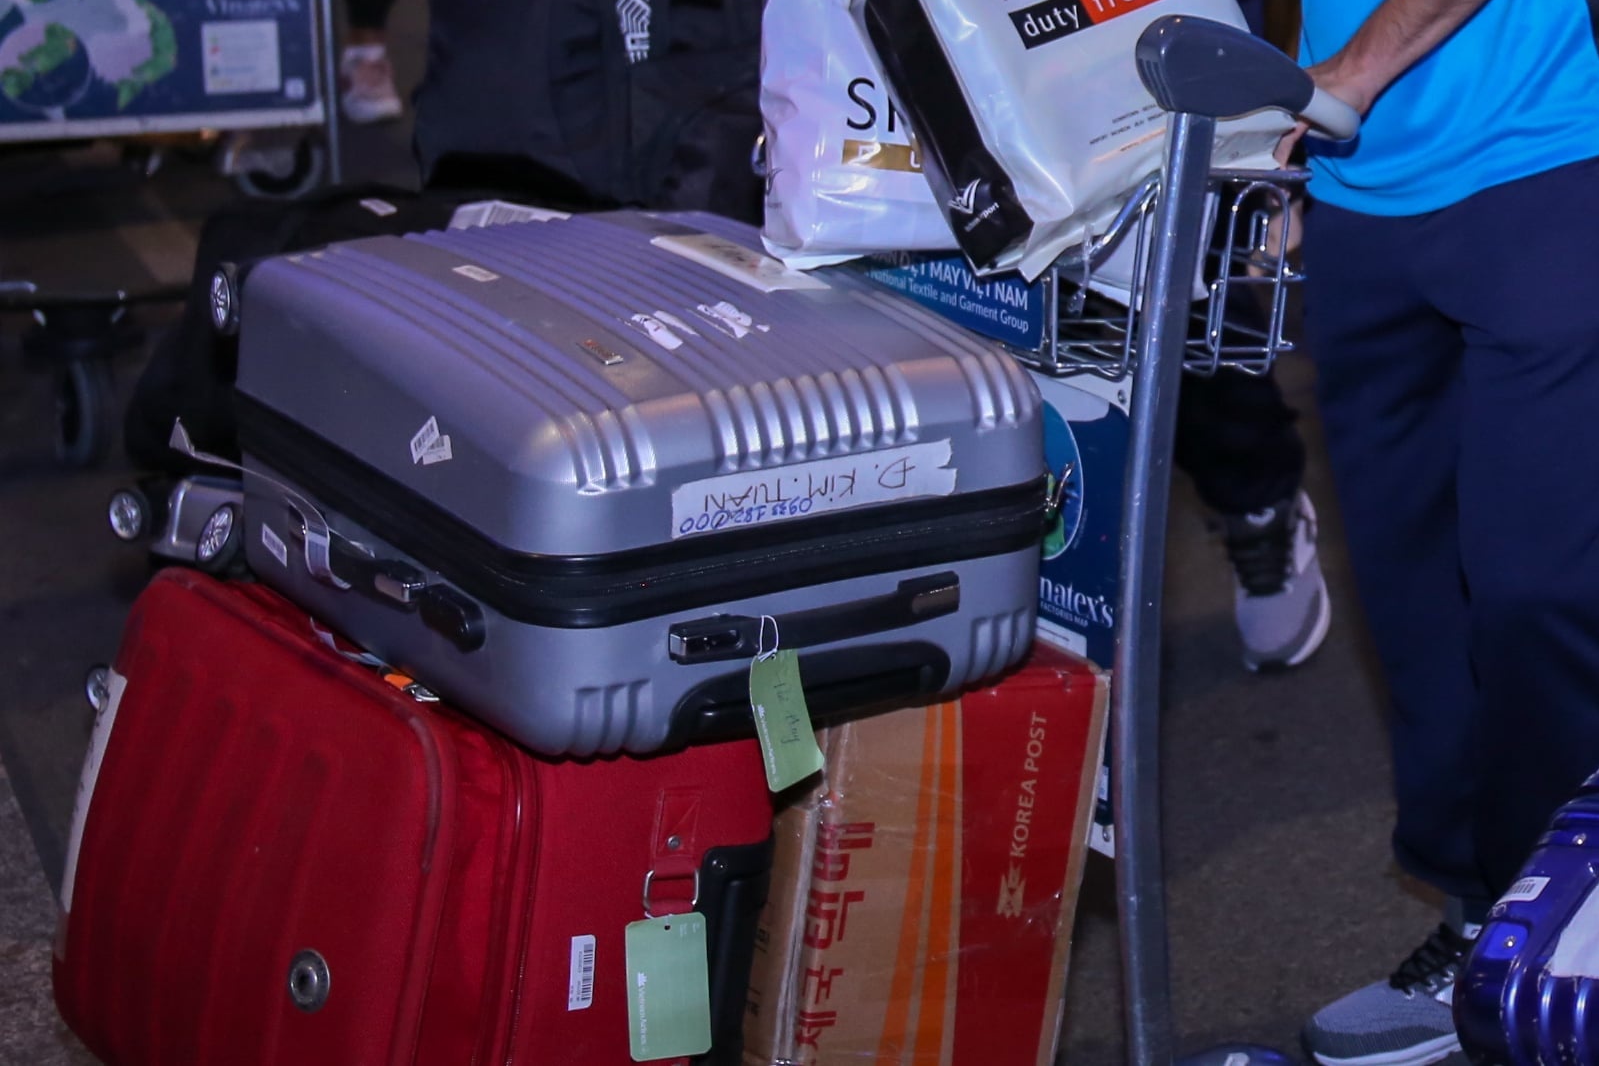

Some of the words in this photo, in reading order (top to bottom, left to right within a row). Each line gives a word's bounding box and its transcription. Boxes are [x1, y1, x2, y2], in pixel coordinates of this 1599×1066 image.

[1023, 4, 1080, 38] duty
[908, 278, 938, 301] Textile
[940, 291, 957, 306] and
[959, 295, 999, 322] Garment
[1000, 309, 1029, 334] Group
[929, 261, 962, 288] MAY
[994, 282, 1028, 311] NAM
[1009, 779, 1038, 858] KOREA
[1024, 711, 1048, 772] POST
